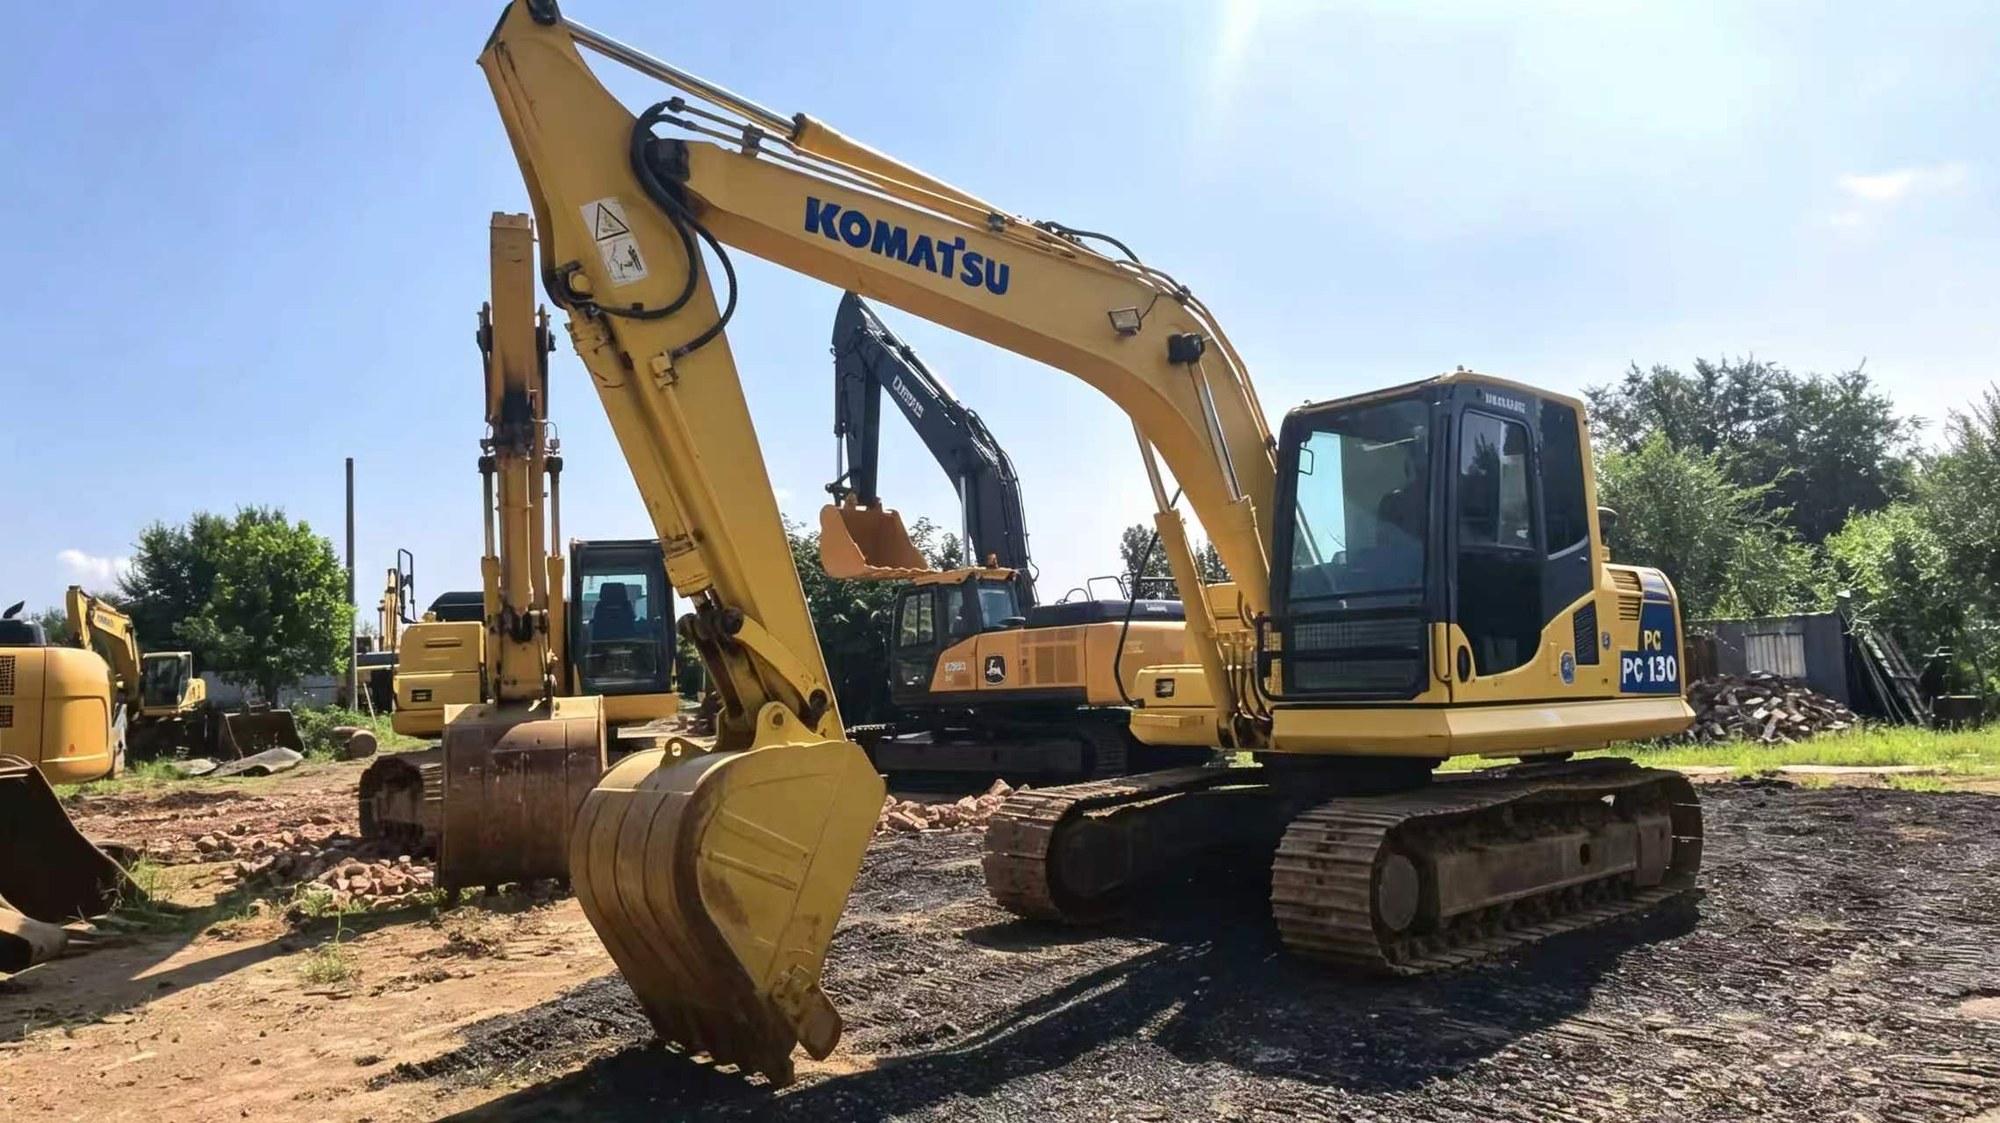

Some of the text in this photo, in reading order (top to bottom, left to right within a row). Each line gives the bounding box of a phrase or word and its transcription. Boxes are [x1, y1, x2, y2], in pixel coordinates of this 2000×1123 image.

[804, 196, 1010, 295] KOMATSU
[1643, 630, 1662, 651] PC
[1622, 655, 1677, 684] PC 130
